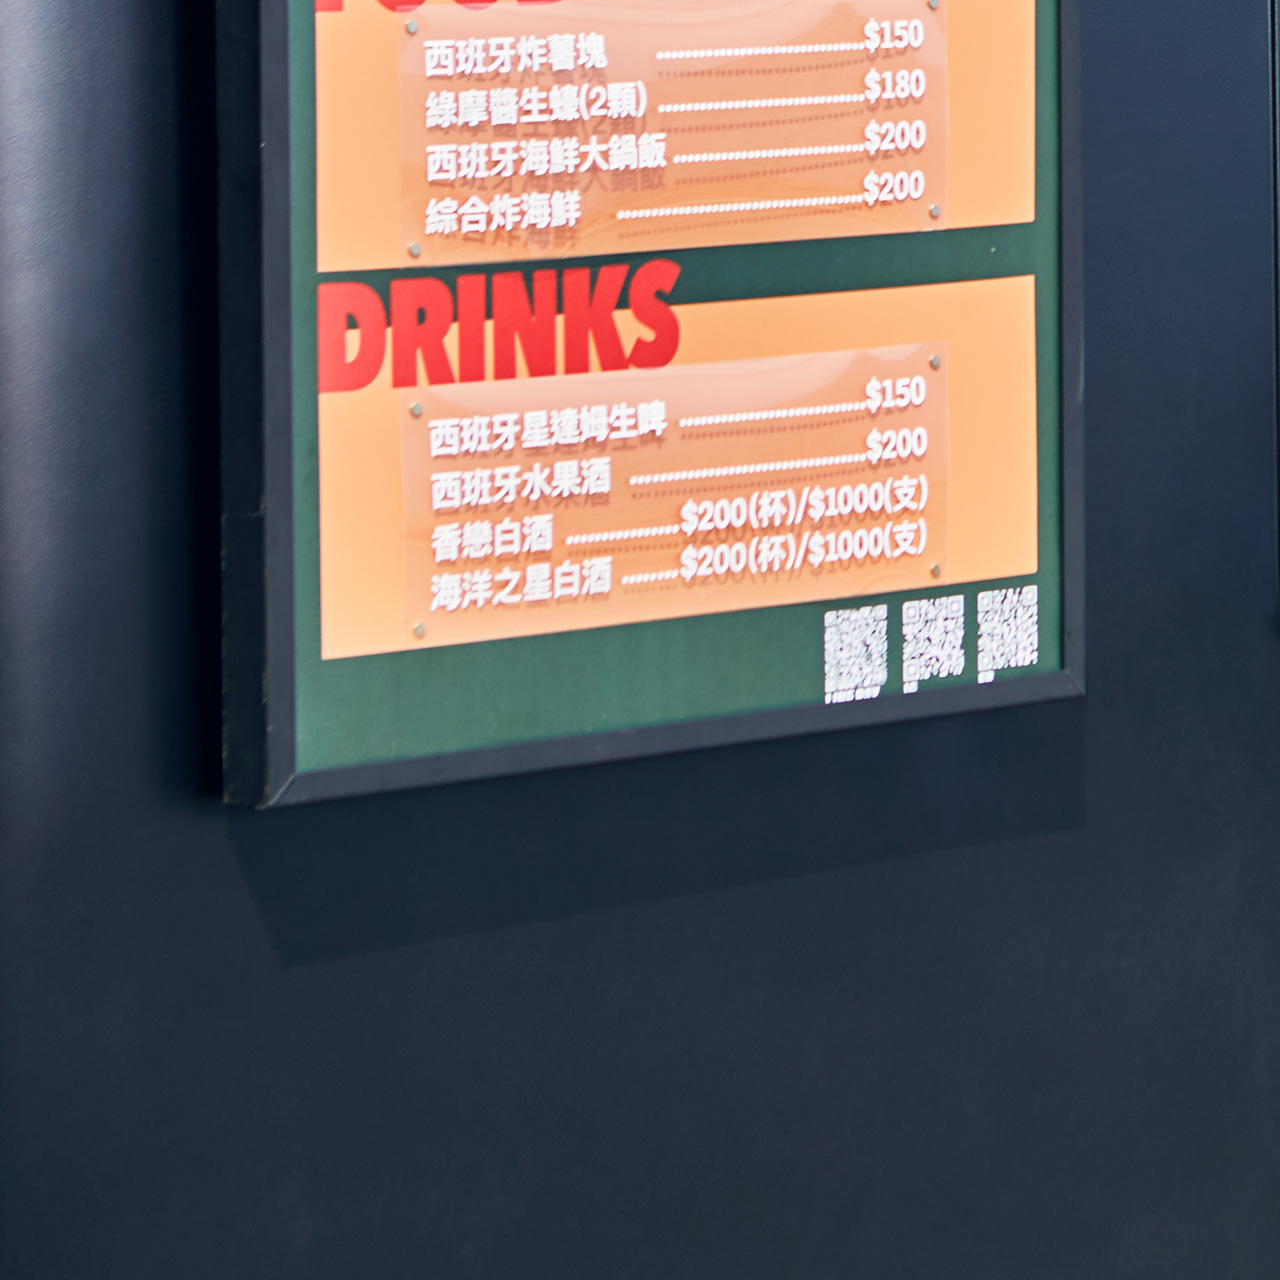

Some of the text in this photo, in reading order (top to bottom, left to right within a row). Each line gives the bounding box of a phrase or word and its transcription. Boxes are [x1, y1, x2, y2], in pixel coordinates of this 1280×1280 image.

[423, 17, 925, 77] 西班牙炸薯塊 $150
[864, 68, 927, 104] $180
[425, 119, 927, 182] 西班牙海鮮大鍋飯 $200
[425, 169, 926, 235] 綜合炸海鮮 $200
[317, 257, 682, 393] DRINKS
[428, 376, 927, 458] 西班牙星達姆生啤 $150
[430, 427, 929, 511] 西班牙水果酒 $200
[680, 473, 929, 536] $200(杯)/$1000(支)
[429, 517, 929, 612] 海洋之星白酒 $200(杯)/$1000(支)
